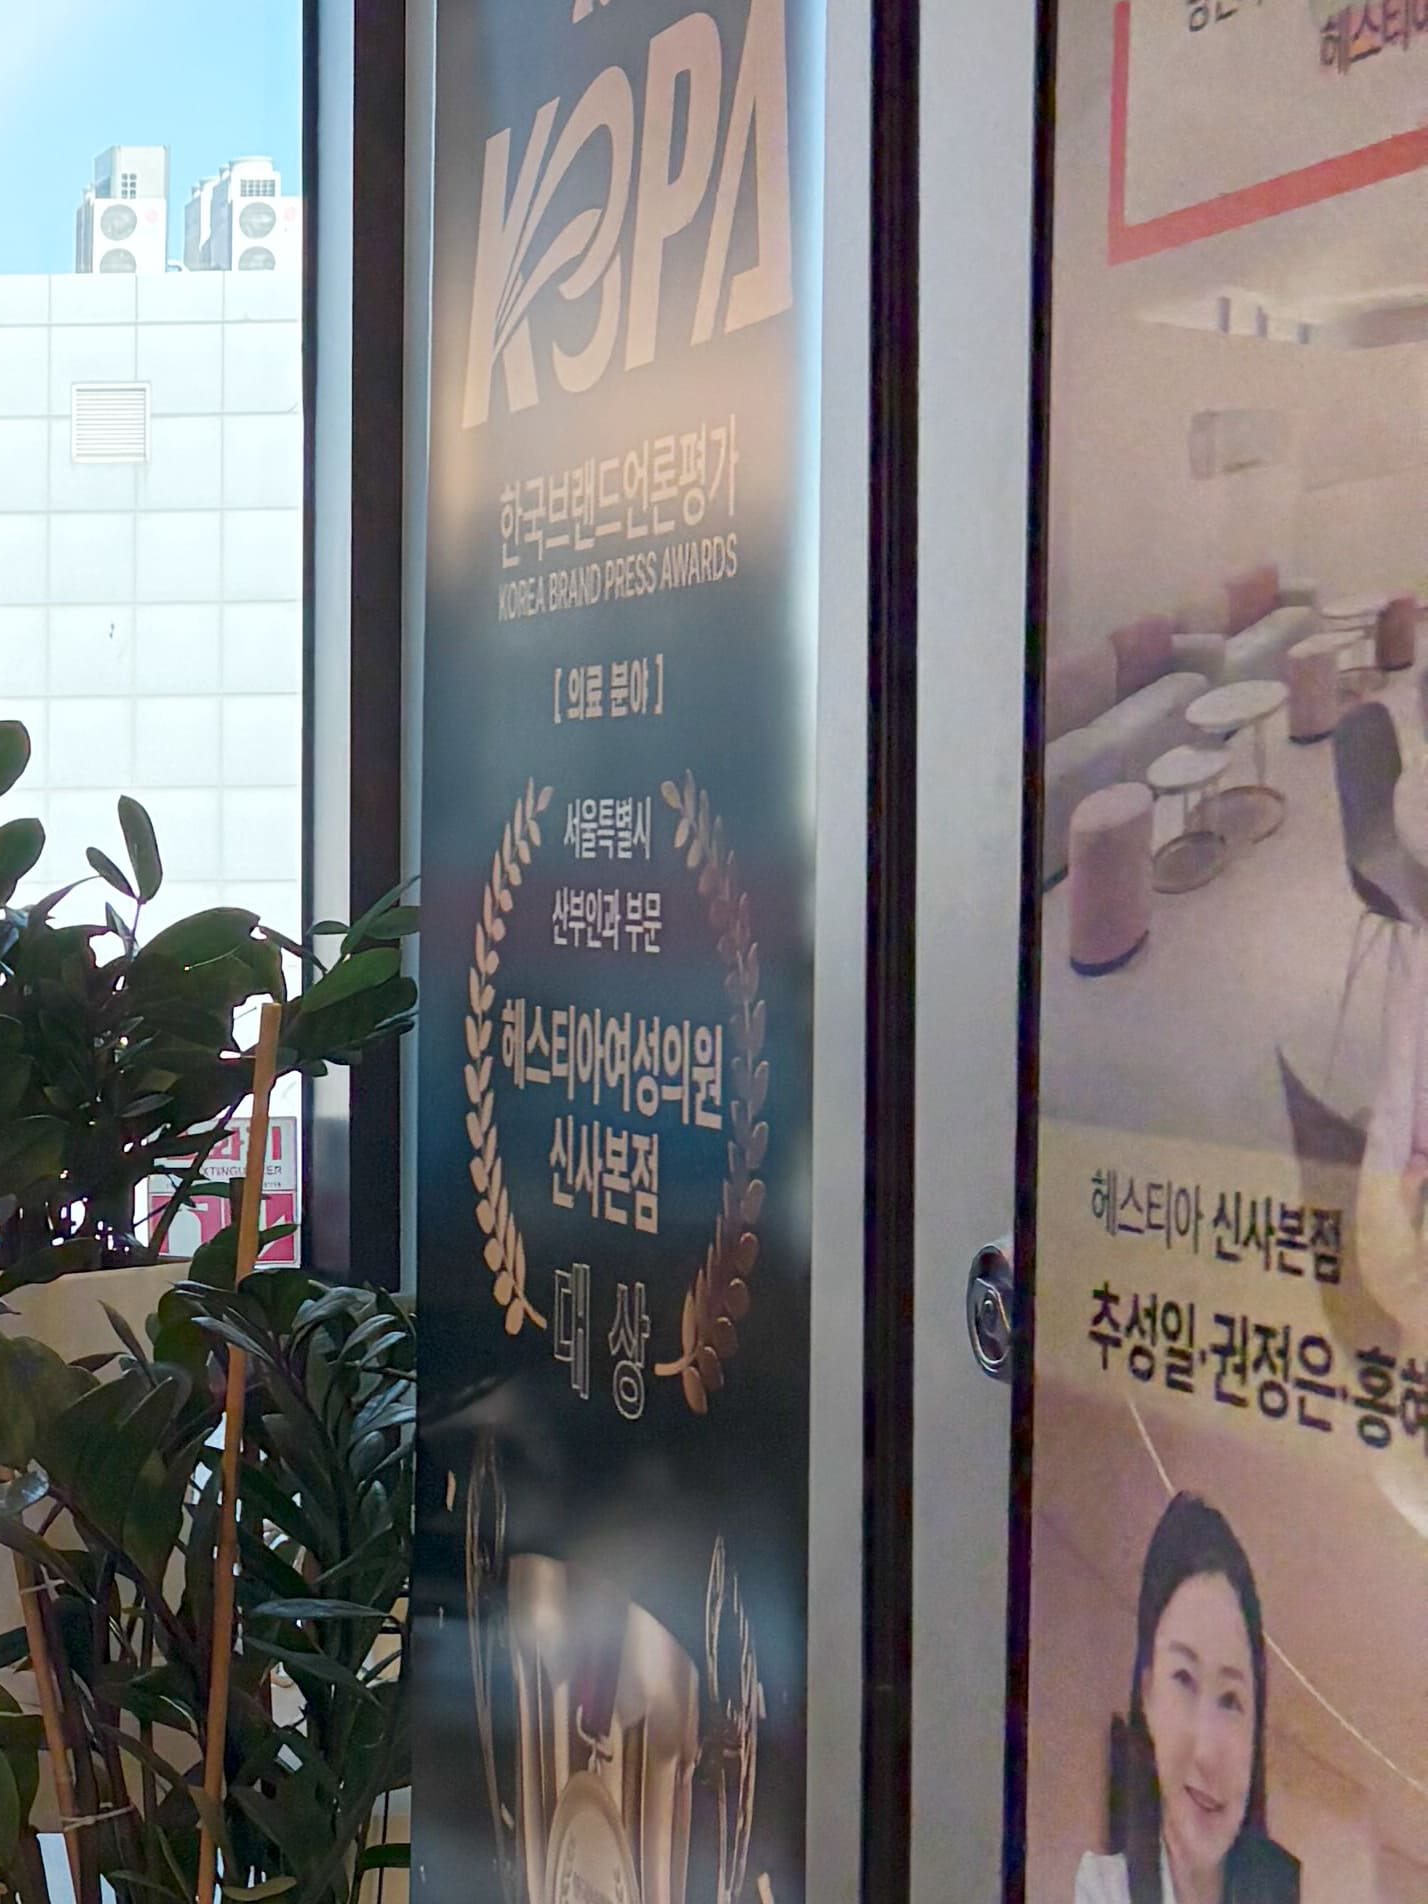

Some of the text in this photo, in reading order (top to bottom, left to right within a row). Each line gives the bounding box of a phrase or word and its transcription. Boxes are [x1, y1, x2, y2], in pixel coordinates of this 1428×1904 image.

[499, 413, 740, 569] 한국브랜드언론평가
[498, 532, 738, 622] KOREA BRAND PRESS AWARDS
[563, 796, 652, 862] 서울특별시
[551, 887, 662, 955] 산부인과 부문
[501, 1004, 724, 1132] 헤스티아여성의원
[549, 1114, 660, 1236] 신사본점
[1090, 1167, 1344, 1286] 헤스티아 신사본점
